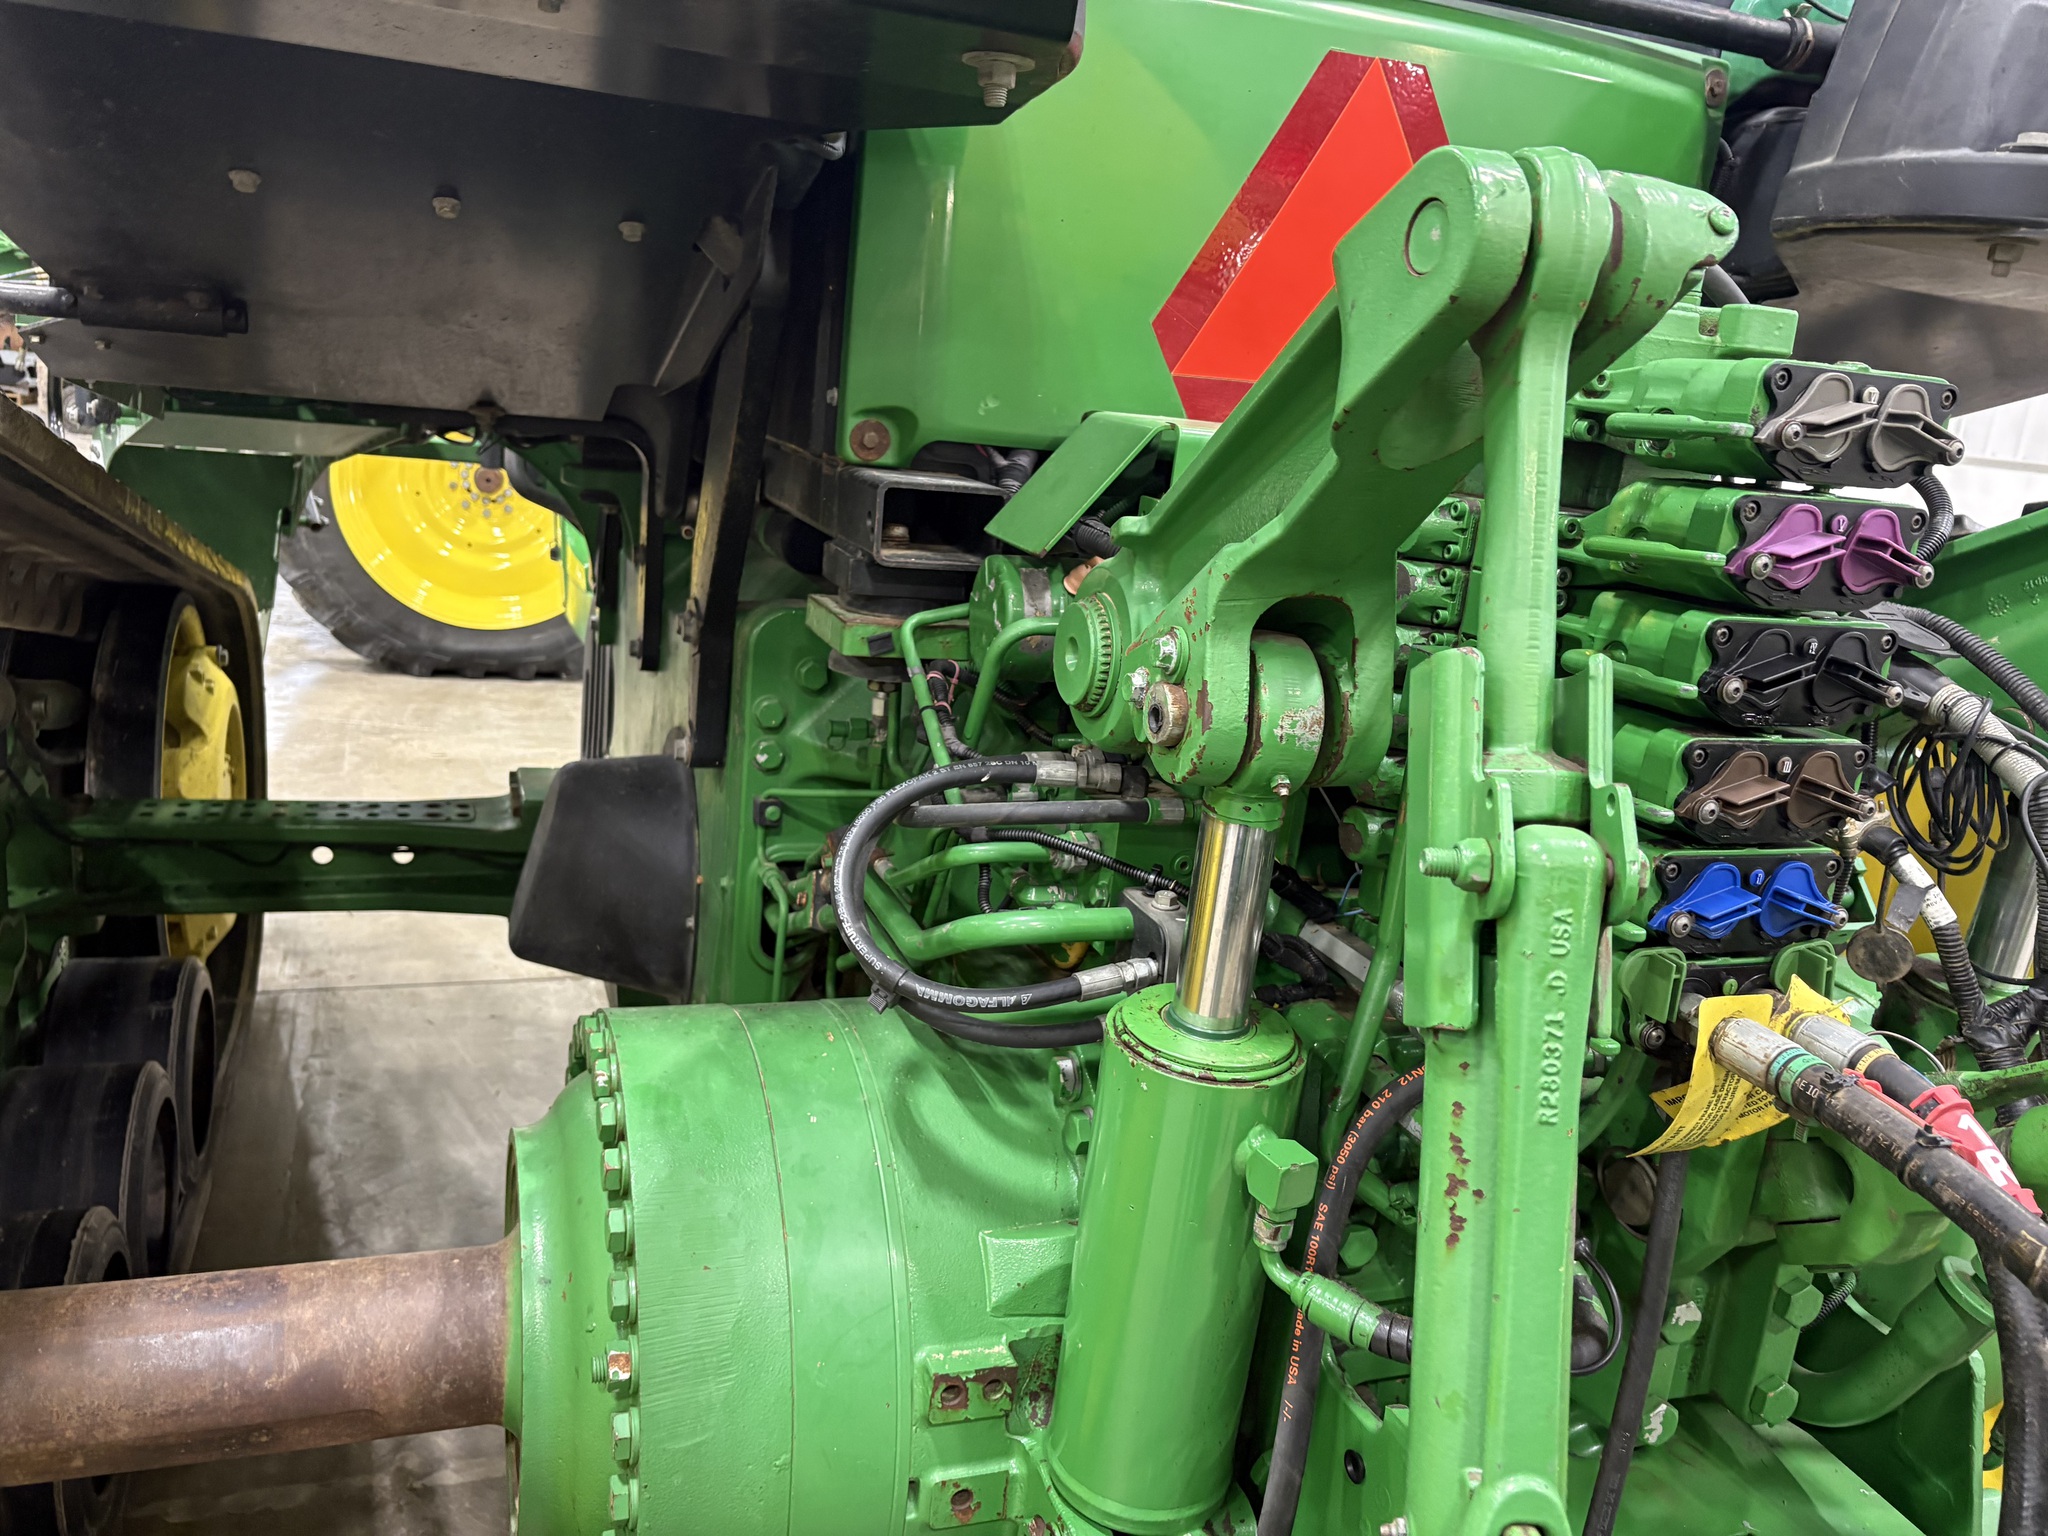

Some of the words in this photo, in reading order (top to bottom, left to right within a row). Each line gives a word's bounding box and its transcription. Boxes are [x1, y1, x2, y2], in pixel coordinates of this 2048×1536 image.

[885, 771, 931, 797] FLEXOPAK
[1548, 907, 1574, 957] USA
[915, 983, 1017, 1008] ALFAGOMMA
[1710, 1084, 1720, 1099] LIFT
[1795, 1077, 1807, 1090] AE
[1371, 1088, 1393, 1110] 210
[1738, 1105, 1764, 1119] MOTOR
[1758, 1094, 1768, 1104] TO
[1355, 1108, 1375, 1130] bar
[1957, 1113, 1993, 1150] 1
[1335, 1130, 1360, 1165] (3050
[1325, 1164, 1340, 1191] psi)
[1975, 1149, 2021, 1188] R
[1312, 1202, 1329, 1232] SAE
[1293, 1308, 1306, 1337] ade
[1291, 1338, 1302, 1353] in
[1287, 1355, 1300, 1385] USA
